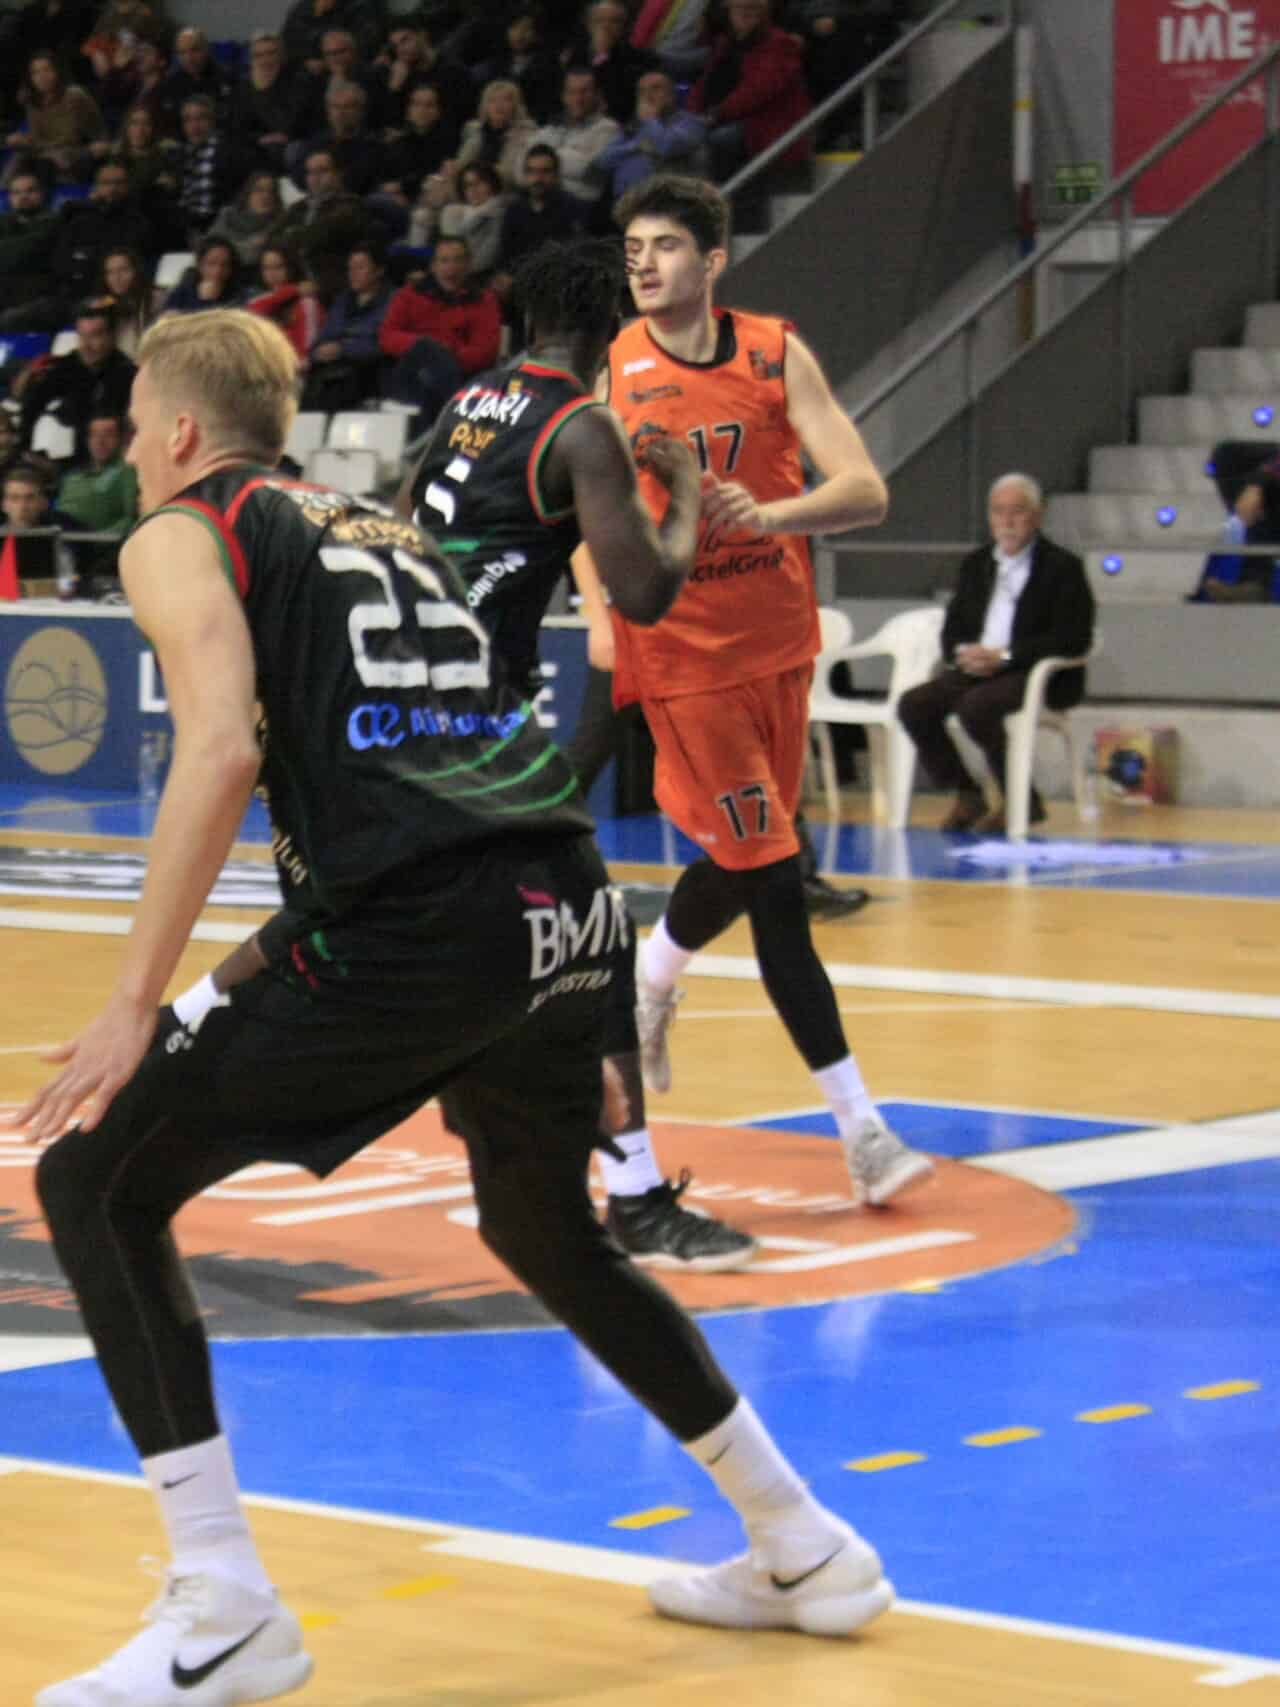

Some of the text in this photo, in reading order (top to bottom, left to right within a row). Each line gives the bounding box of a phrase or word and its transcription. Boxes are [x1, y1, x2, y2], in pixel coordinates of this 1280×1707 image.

[1158, 11, 1256, 64] IME
[687, 421, 745, 473] 17
[714, 781, 769, 842] 17
